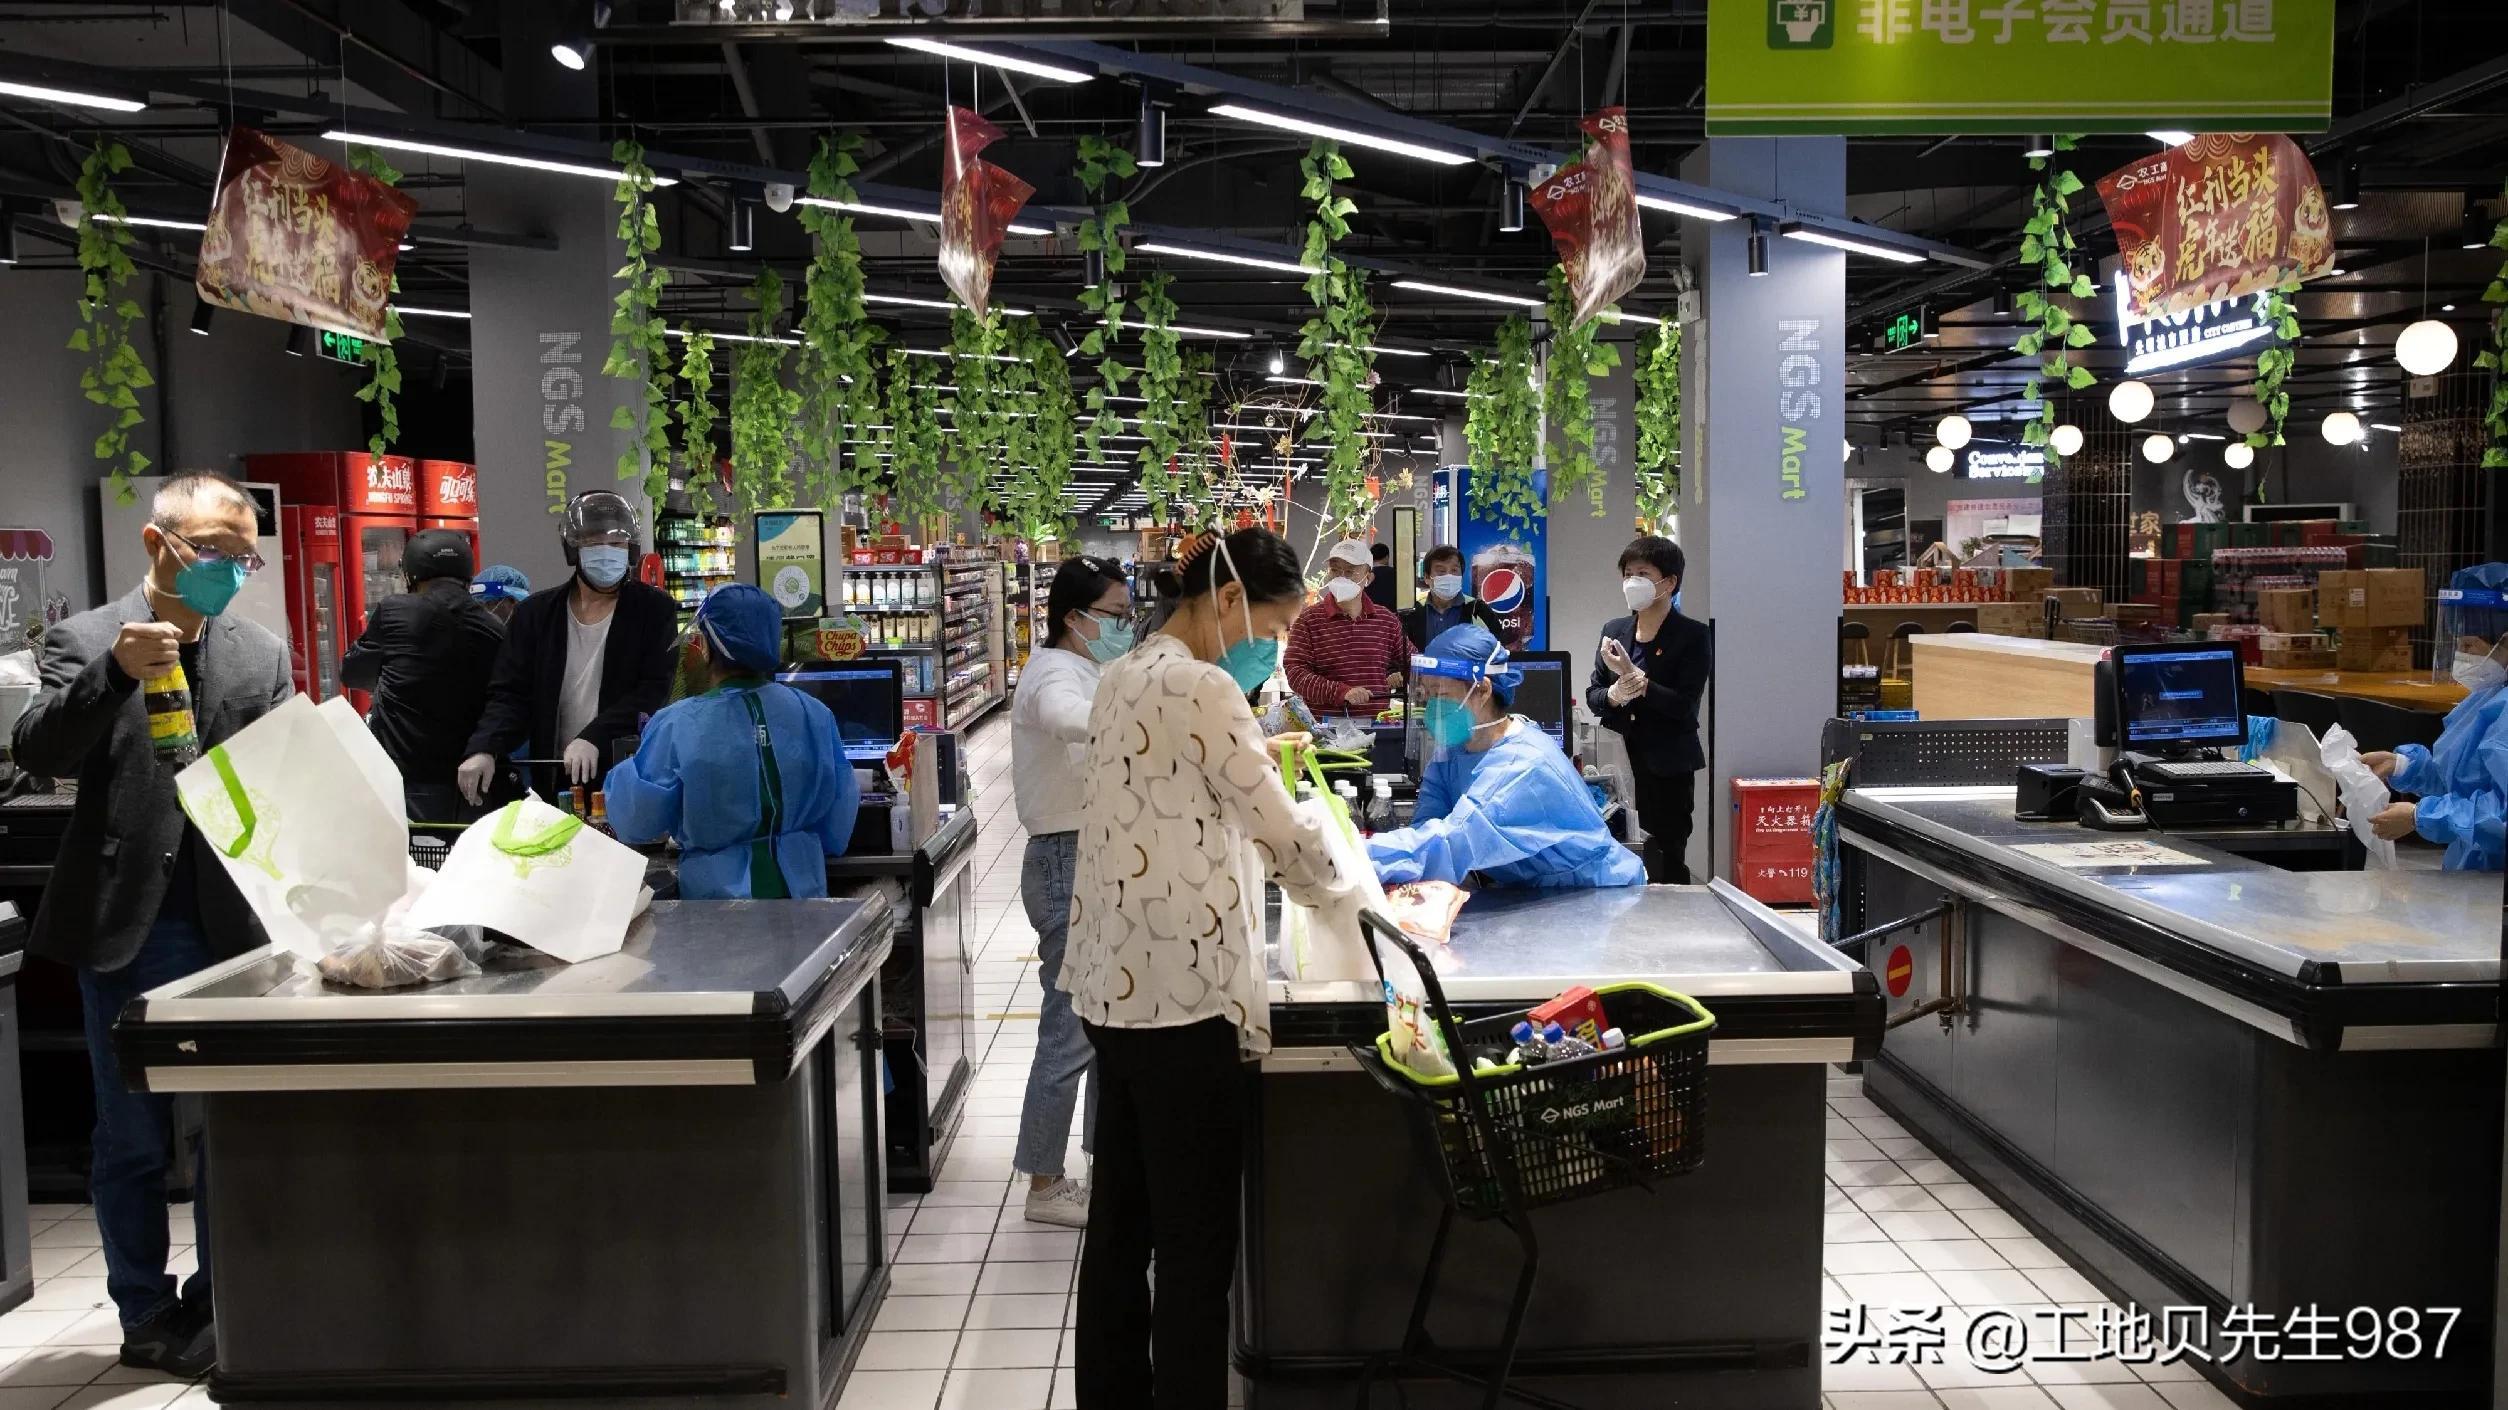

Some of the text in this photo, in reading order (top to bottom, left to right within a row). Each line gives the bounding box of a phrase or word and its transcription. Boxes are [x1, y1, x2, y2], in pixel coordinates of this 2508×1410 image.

[1857, 0, 2276, 44] 非电子会员通道
[2176, 146, 2280, 226] 红利当头
[2174, 196, 2279, 283] 虎年送福
[539, 332, 585, 514] NGS Mart
[1779, 320, 1821, 500] NGS Mart
[825, 631, 858, 641] Chupa
[1499, 617, 1522, 630] psi
[825, 641, 857, 652] Chups
[1788, 867, 1808, 878] 119
[1563, 1096, 1624, 1121] NGS Mart
